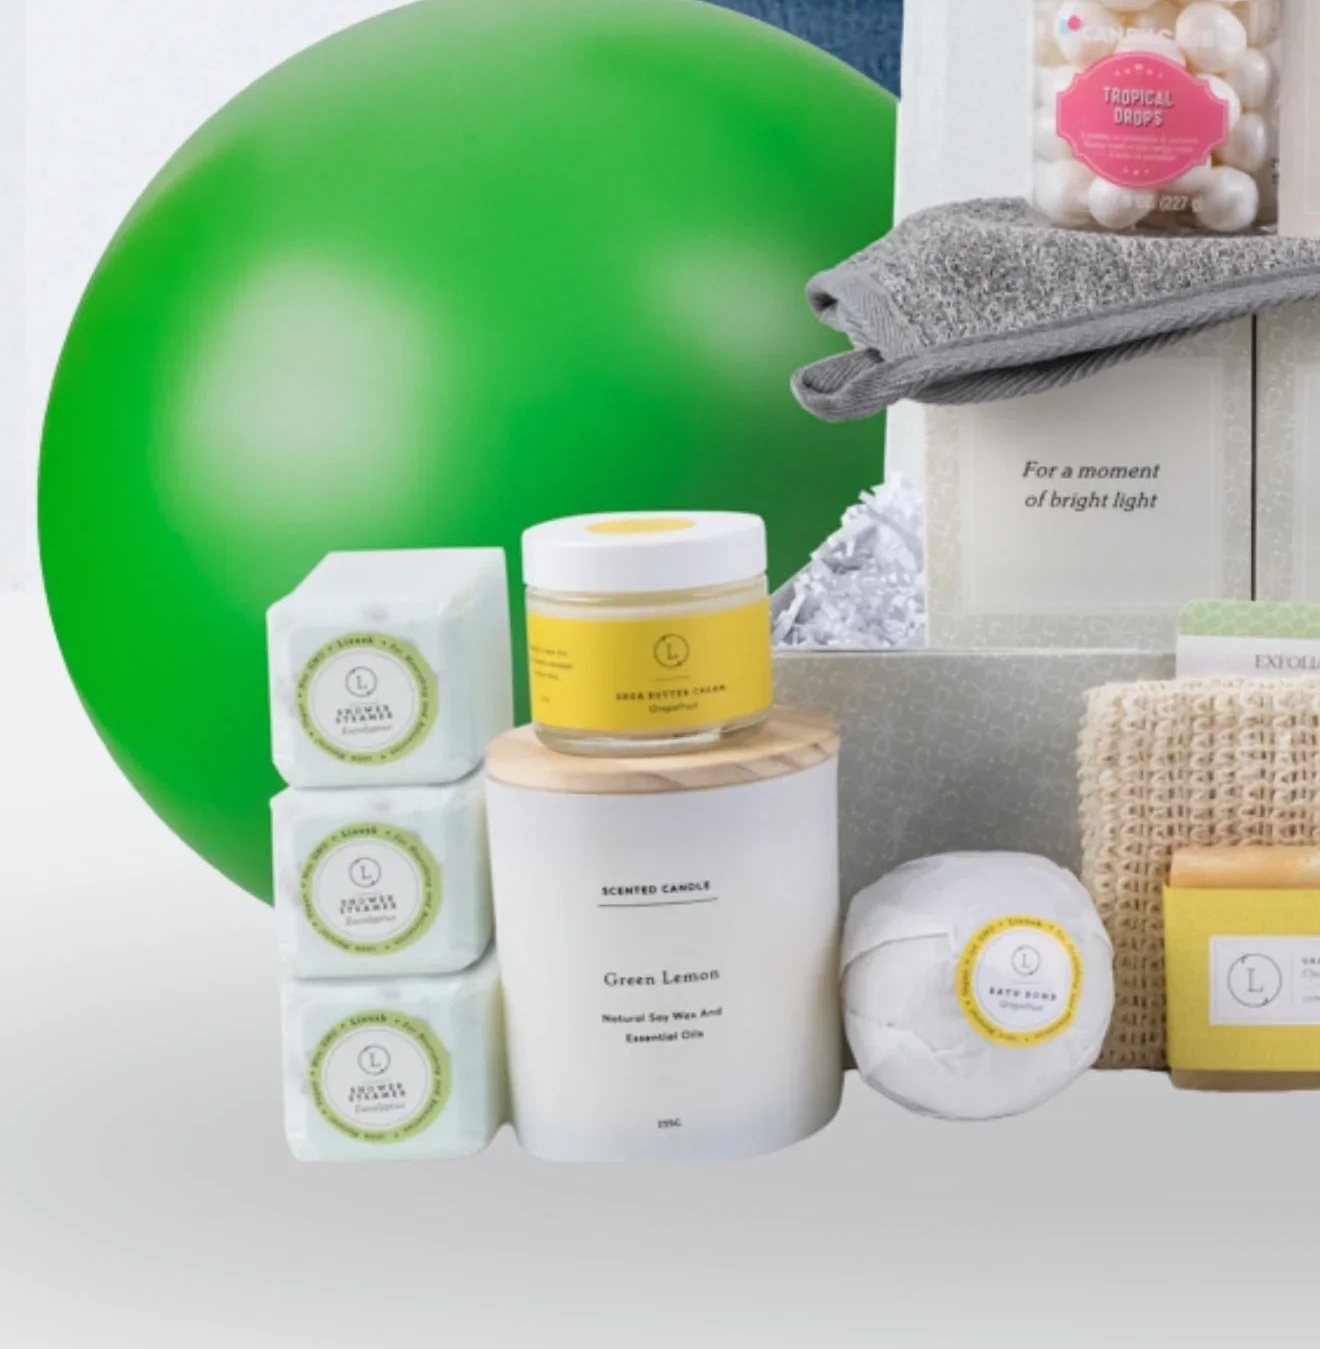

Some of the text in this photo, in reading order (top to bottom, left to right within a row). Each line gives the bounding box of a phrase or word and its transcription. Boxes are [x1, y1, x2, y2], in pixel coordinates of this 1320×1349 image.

[1103, 87, 1175, 109] TROPICAL
[1113, 108, 1165, 128] DROPS
[1022, 460, 1160, 479] For a moment
[1024, 489, 1158, 512] of bright light
[666, 643, 679, 661] L
[336, 712, 393, 724] STEAMER
[337, 704, 391, 717] SHOWER
[601, 880, 711, 896] SCENTED CANDLE
[603, 968, 720, 987] Green Lemon
[1246, 967, 1264, 993] L
[601, 1007, 723, 1024] Natural Soy Wax And
[625, 1029, 704, 1043] Essential Oils
